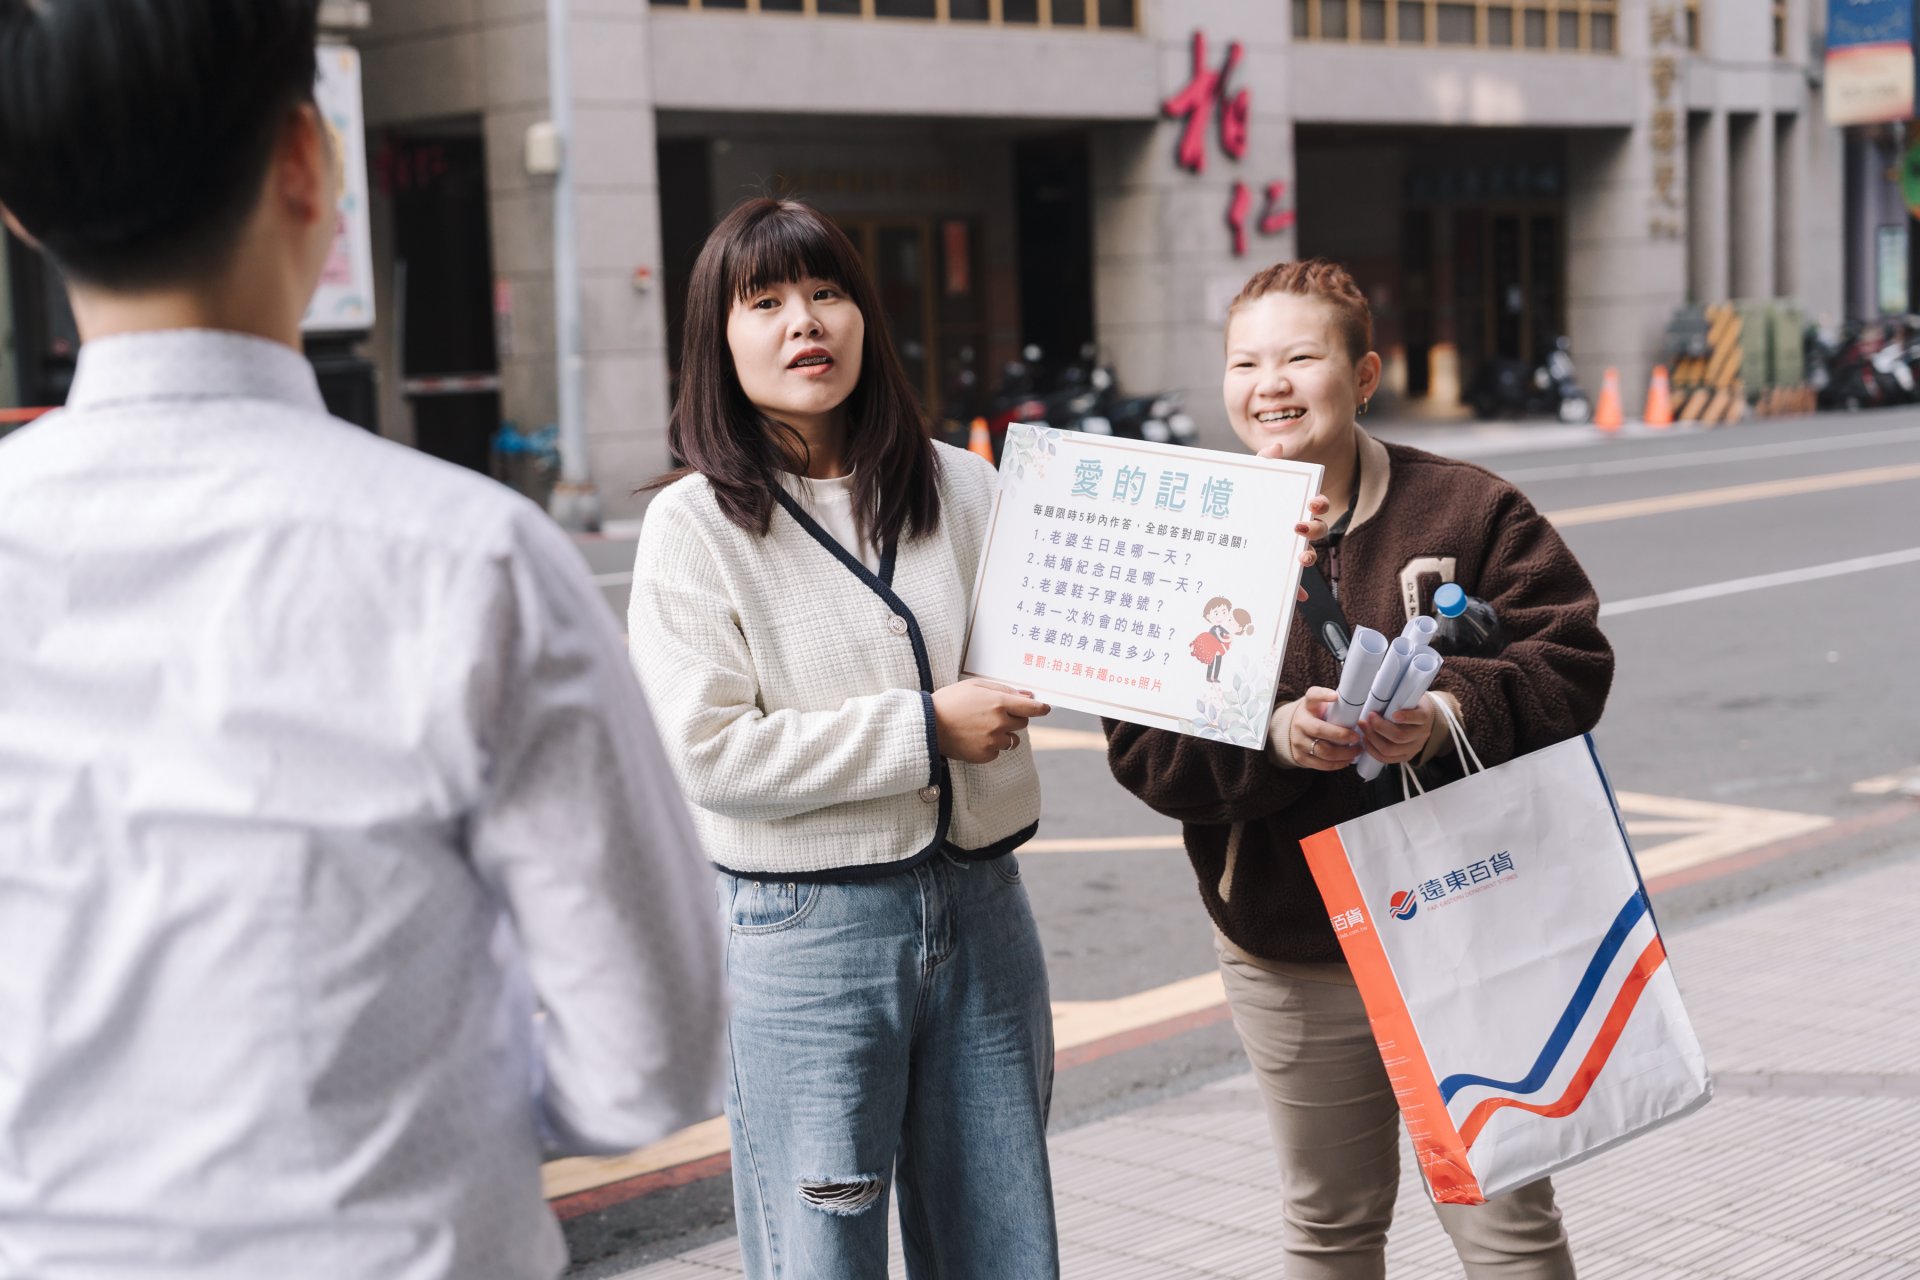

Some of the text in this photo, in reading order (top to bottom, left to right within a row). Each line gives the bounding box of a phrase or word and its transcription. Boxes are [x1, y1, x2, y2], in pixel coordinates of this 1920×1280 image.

[1071, 458, 1235, 518] 愛的記憶
[1418, 850, 1515, 902] 遠東百貨
[1330, 907, 1364, 931] 百貨
